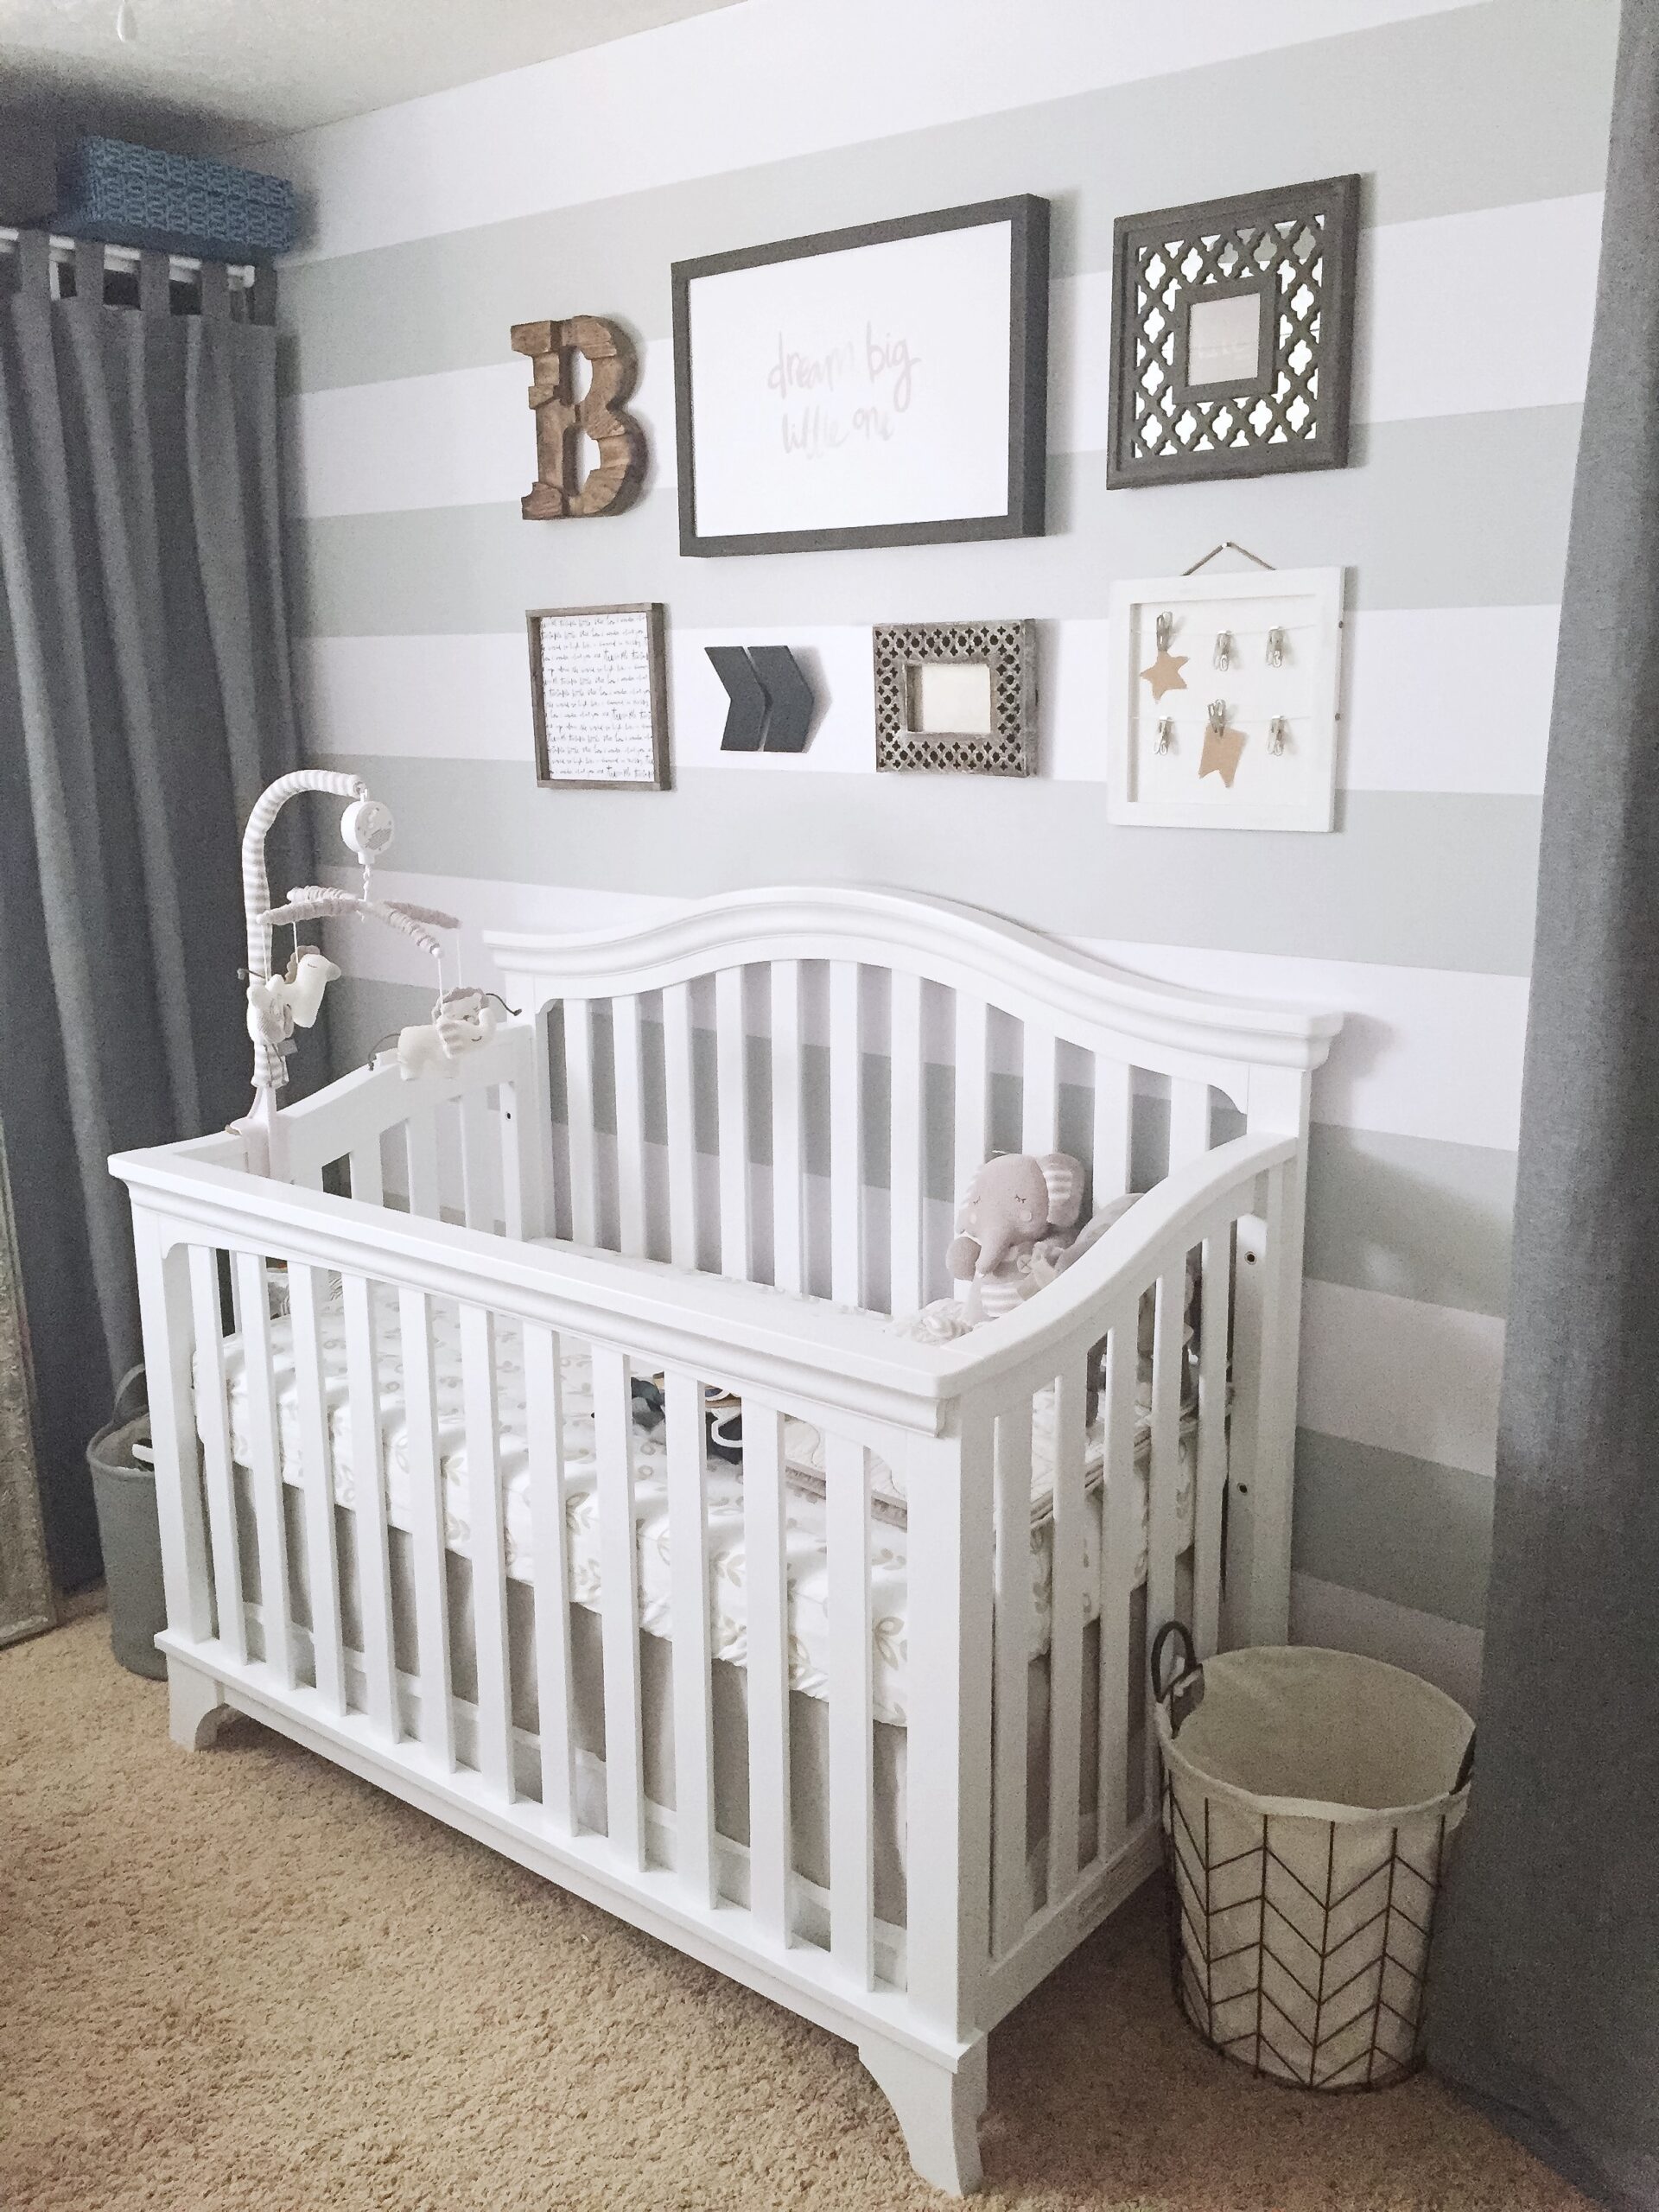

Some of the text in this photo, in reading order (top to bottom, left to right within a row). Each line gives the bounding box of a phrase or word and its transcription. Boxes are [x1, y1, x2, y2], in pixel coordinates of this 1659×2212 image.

[511, 315, 649, 520] B
[767, 321, 922, 413] dream big
